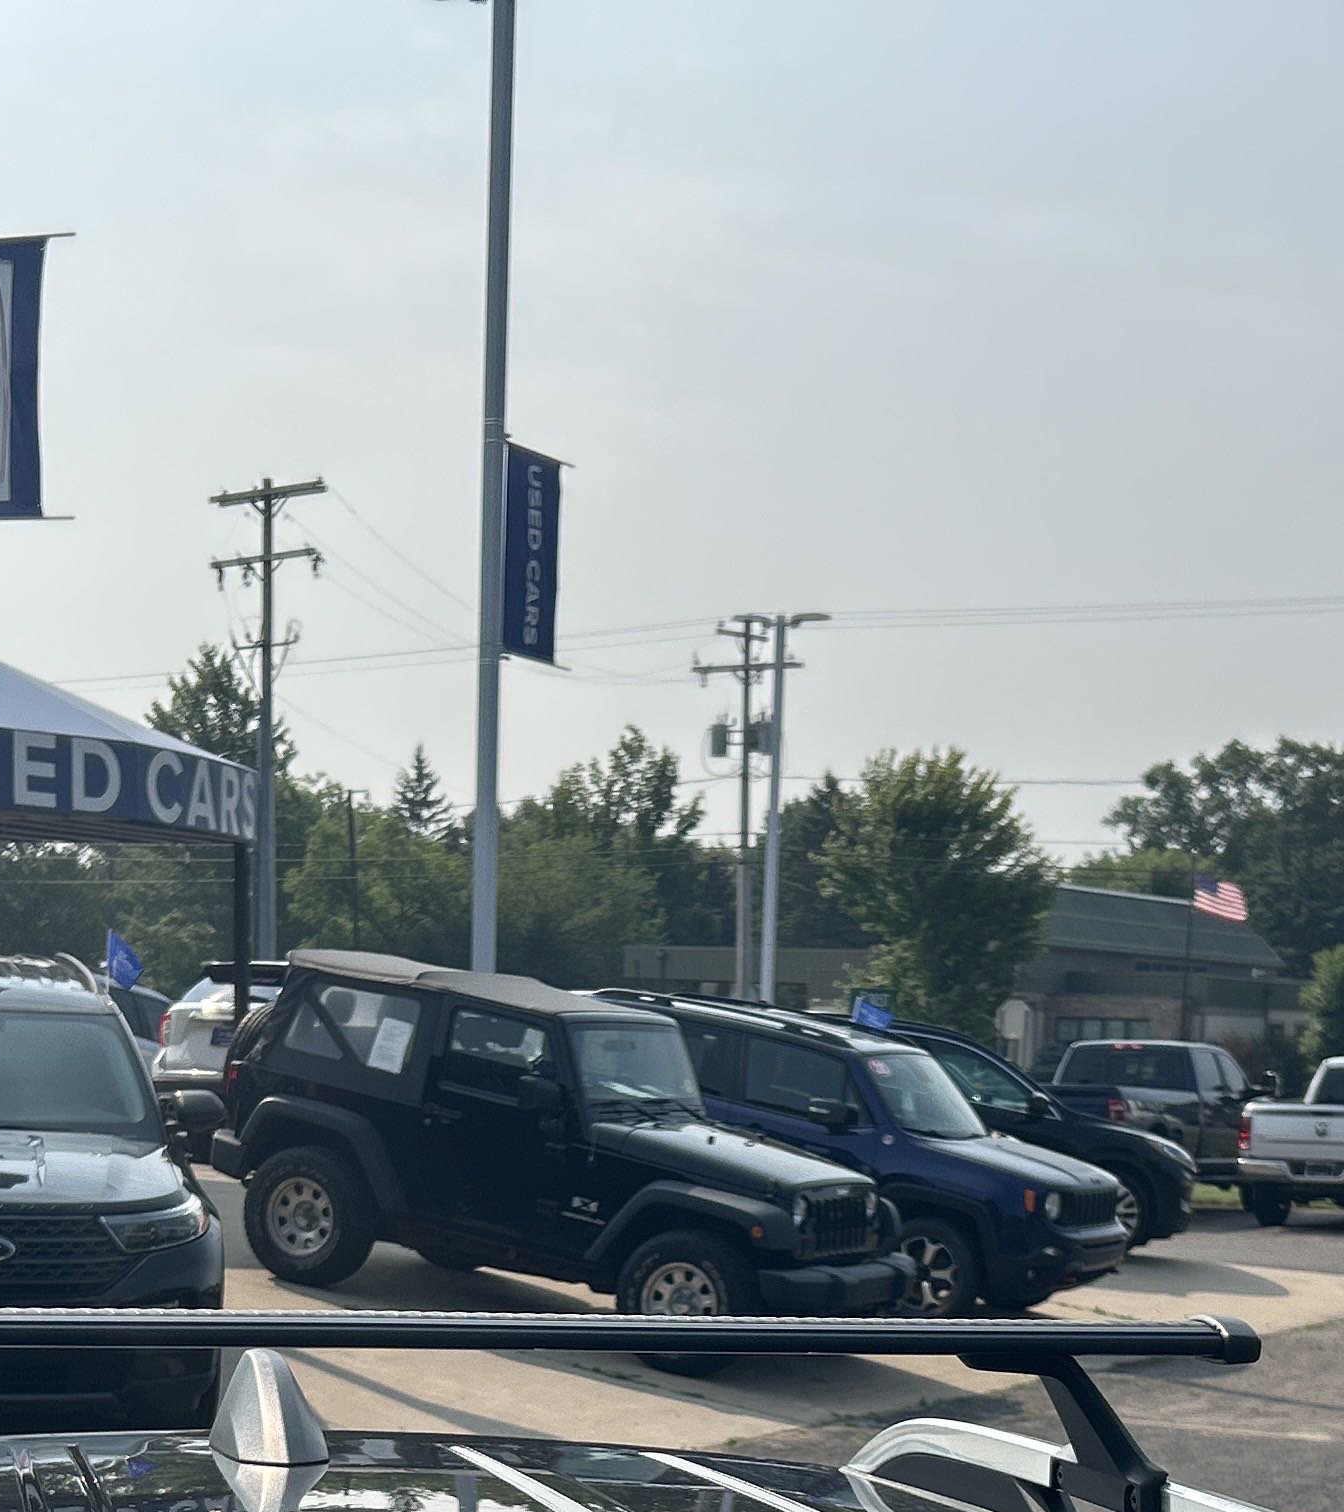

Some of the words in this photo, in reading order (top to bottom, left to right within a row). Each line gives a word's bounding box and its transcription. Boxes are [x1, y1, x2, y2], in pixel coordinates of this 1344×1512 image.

[527, 465, 543, 550] USED
[522, 559, 542, 646] CARS
[146, 750, 257, 840] CARS
